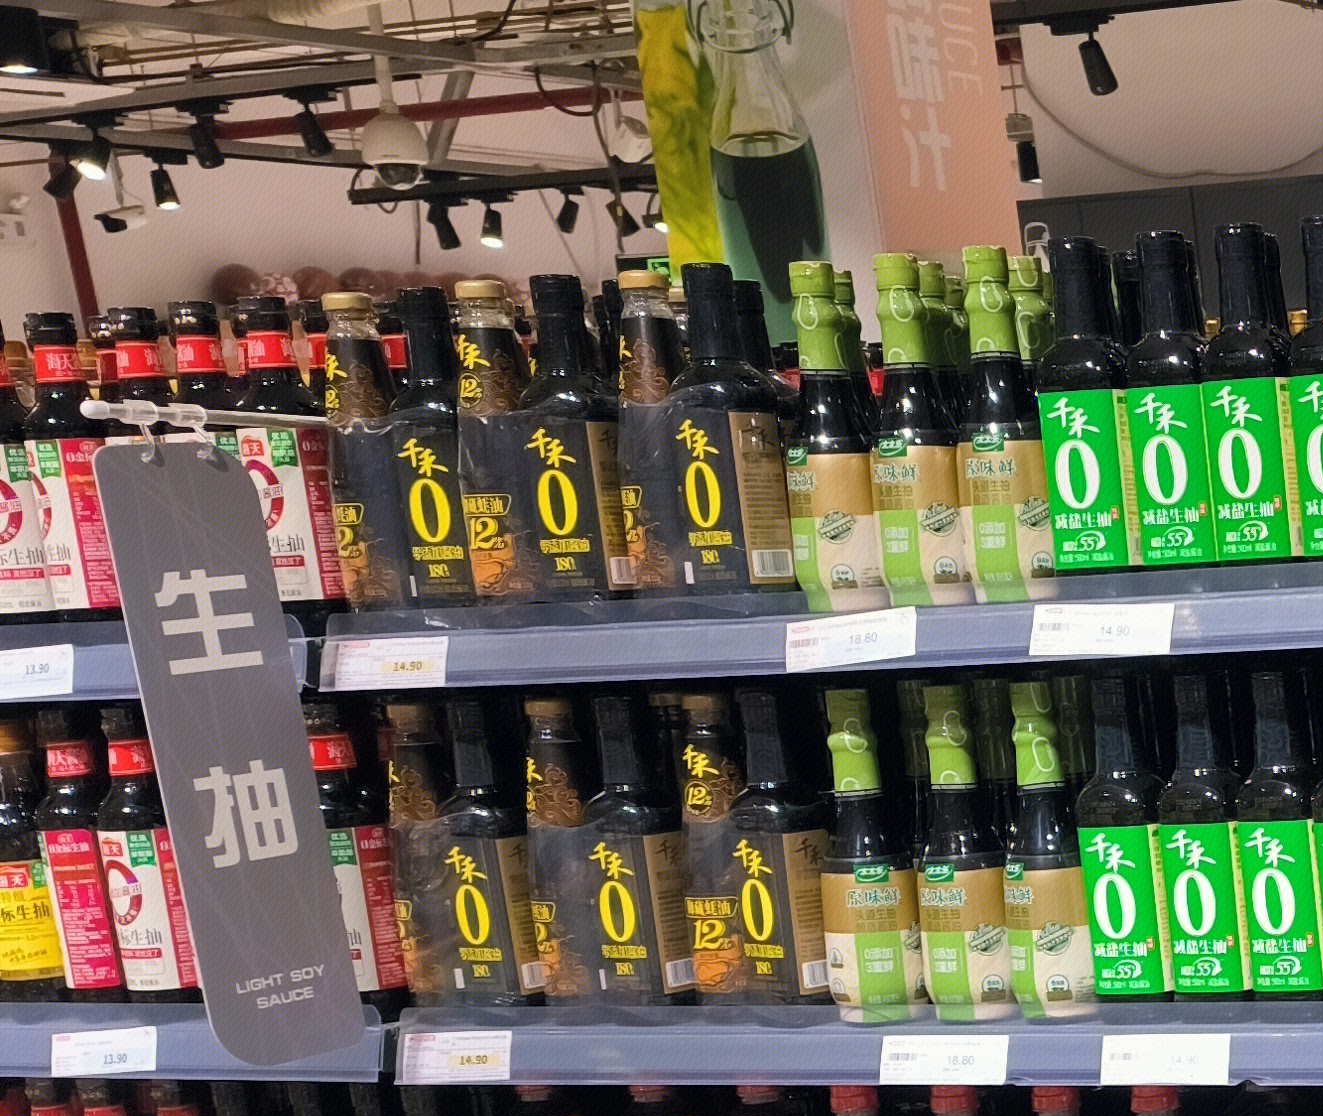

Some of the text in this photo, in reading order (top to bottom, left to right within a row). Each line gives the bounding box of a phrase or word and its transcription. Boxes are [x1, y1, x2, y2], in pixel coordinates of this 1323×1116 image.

[1047, 398, 1104, 436] 千禾
[1055, 440, 1100, 510] 0
[409, 478, 451, 543] 0
[537, 469, 578, 536] 0
[392, 660, 424, 672] 14.90
[1085, 829, 1135, 870] 千禾
[599, 880, 636, 943] 0
[1092, 868, 1137, 939] 0
[235, 964, 325, 996] LIGHT SOY
[255, 985, 316, 1011] SAUCE
